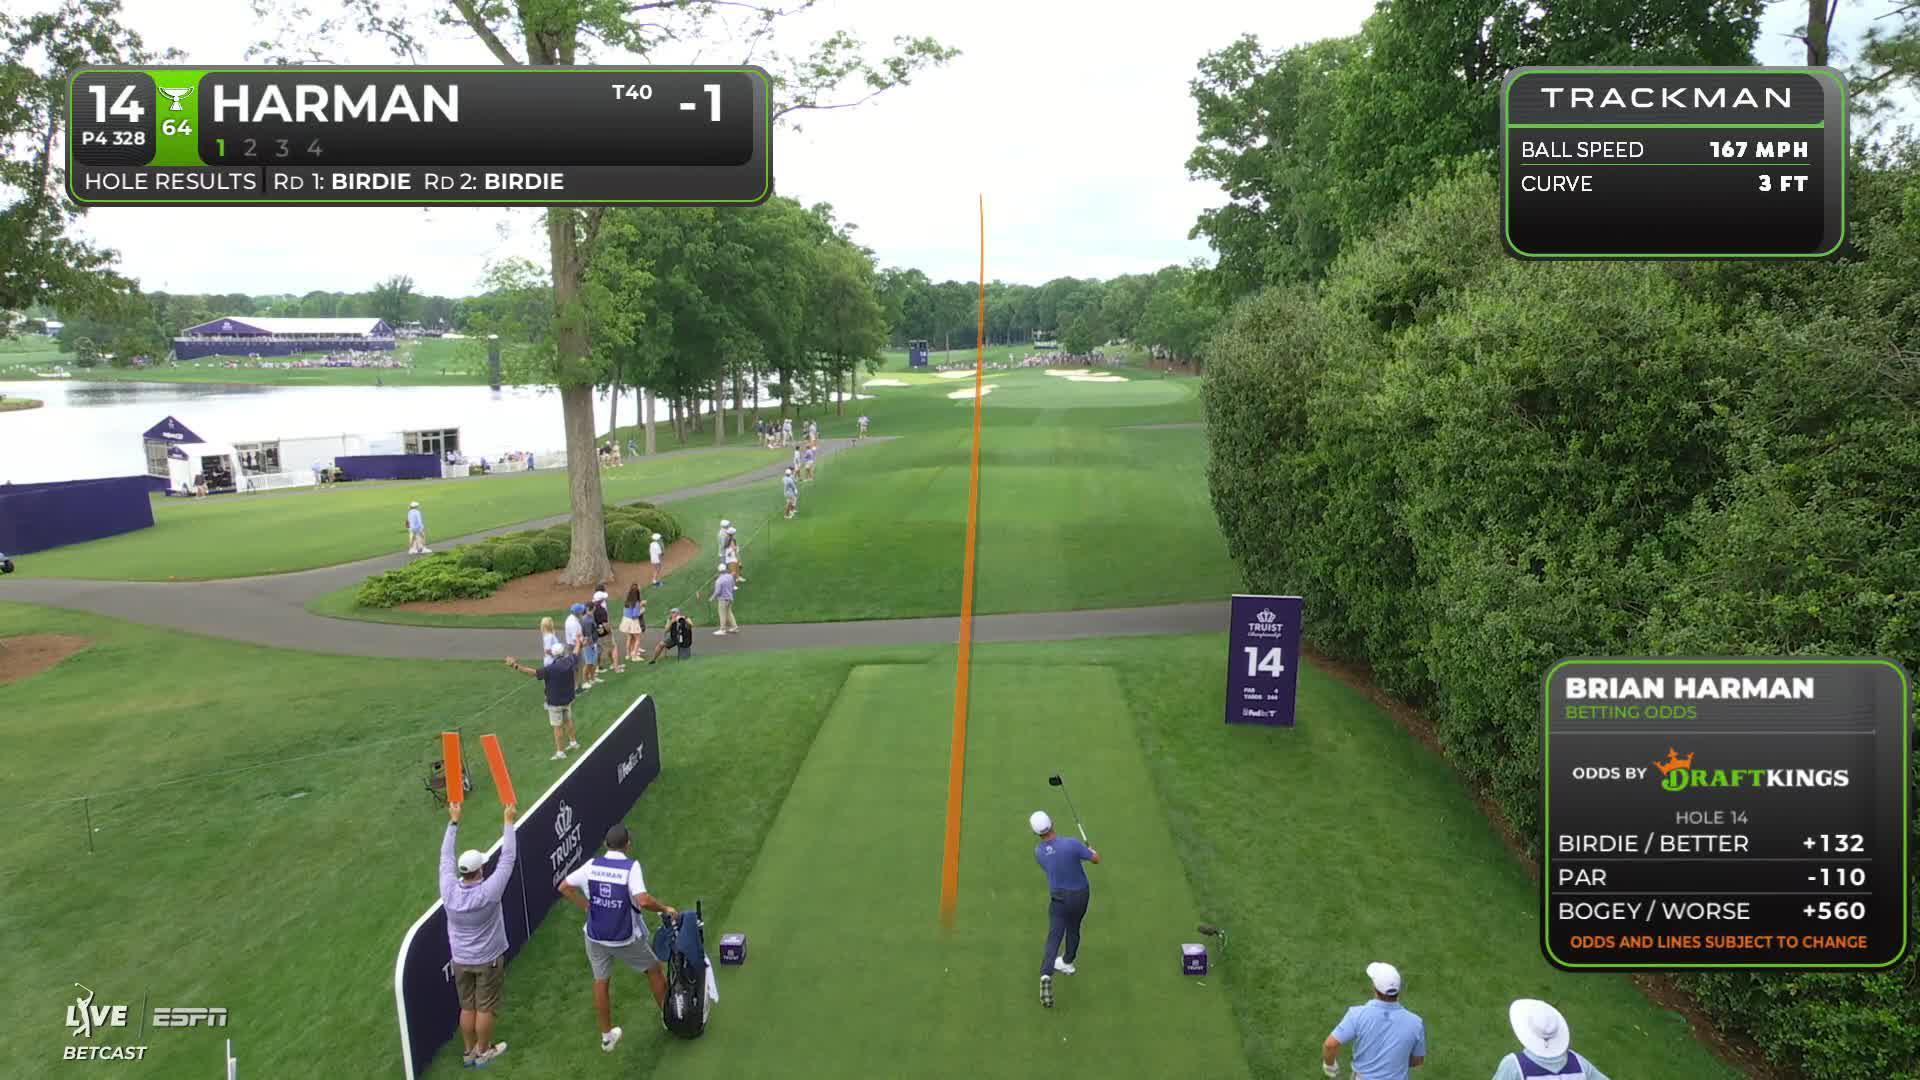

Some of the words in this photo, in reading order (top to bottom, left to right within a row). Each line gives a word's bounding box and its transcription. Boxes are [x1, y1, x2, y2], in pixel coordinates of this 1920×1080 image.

[1247, 622, 1283, 632] TRUIST
[1244, 646, 1285, 678] 14
[550, 822, 581, 870] TRUIST
